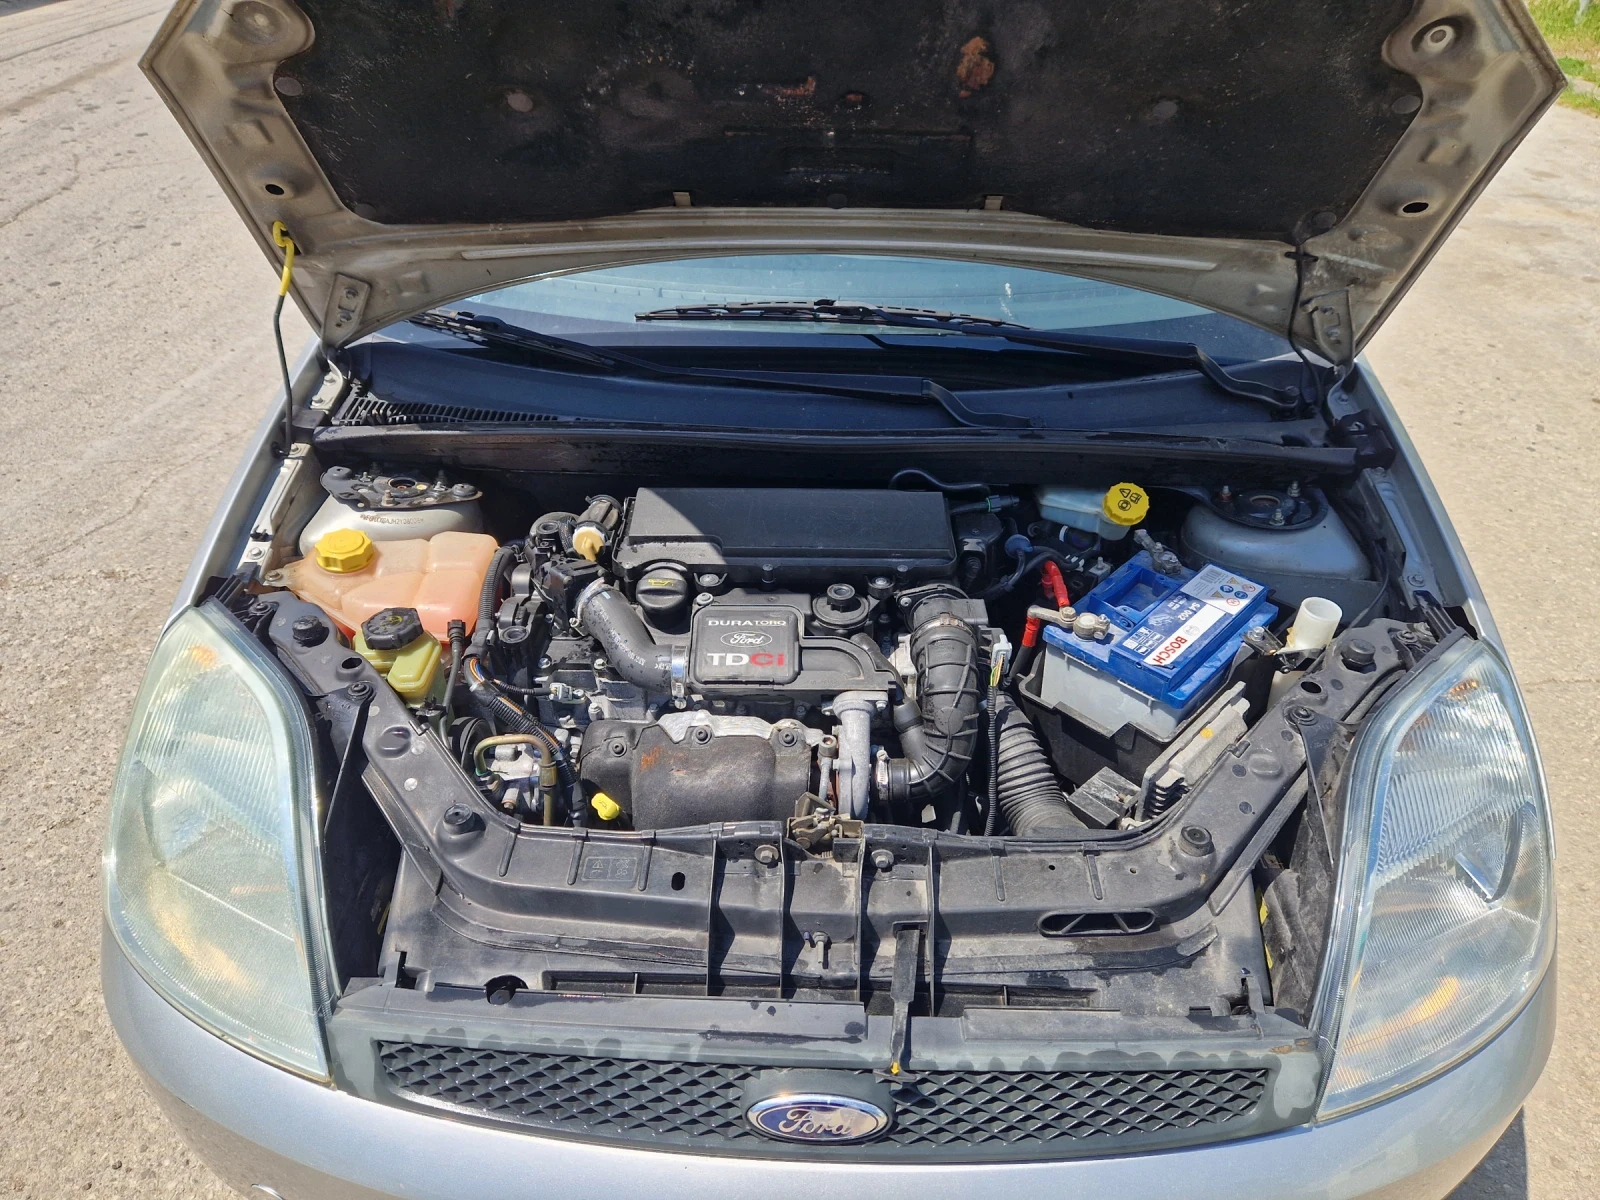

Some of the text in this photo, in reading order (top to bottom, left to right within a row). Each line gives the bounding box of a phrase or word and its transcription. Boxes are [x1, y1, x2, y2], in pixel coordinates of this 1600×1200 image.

[730, 633, 765, 645] Ford
[1152, 635, 1188, 664] BOSCH
[707, 653, 785, 667] TDCi
[778, 1108, 855, 1135] Ford
